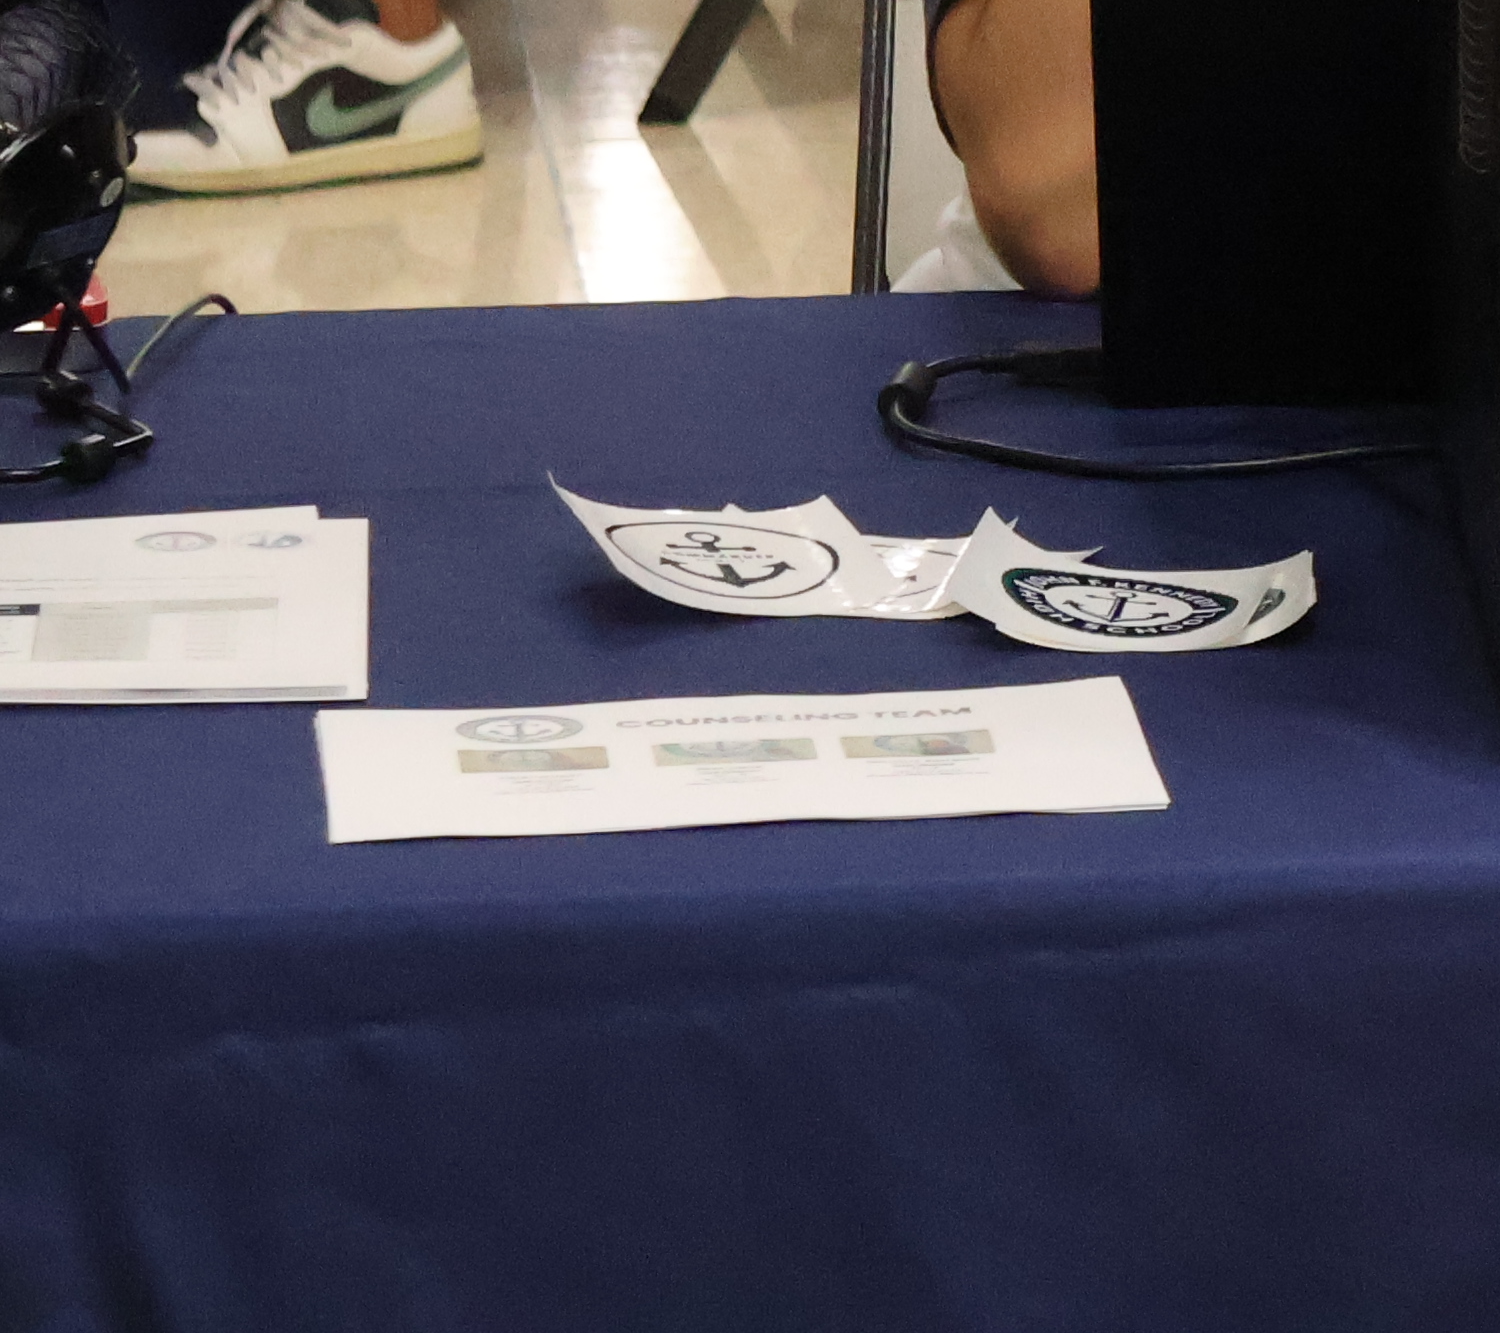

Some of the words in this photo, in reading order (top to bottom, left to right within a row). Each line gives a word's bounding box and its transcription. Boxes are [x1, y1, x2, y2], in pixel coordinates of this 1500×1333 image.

[1083, 612, 1217, 634] SCHOOL
[616, 712, 858, 729] COUNSELING
[871, 706, 972, 720] TEAM
